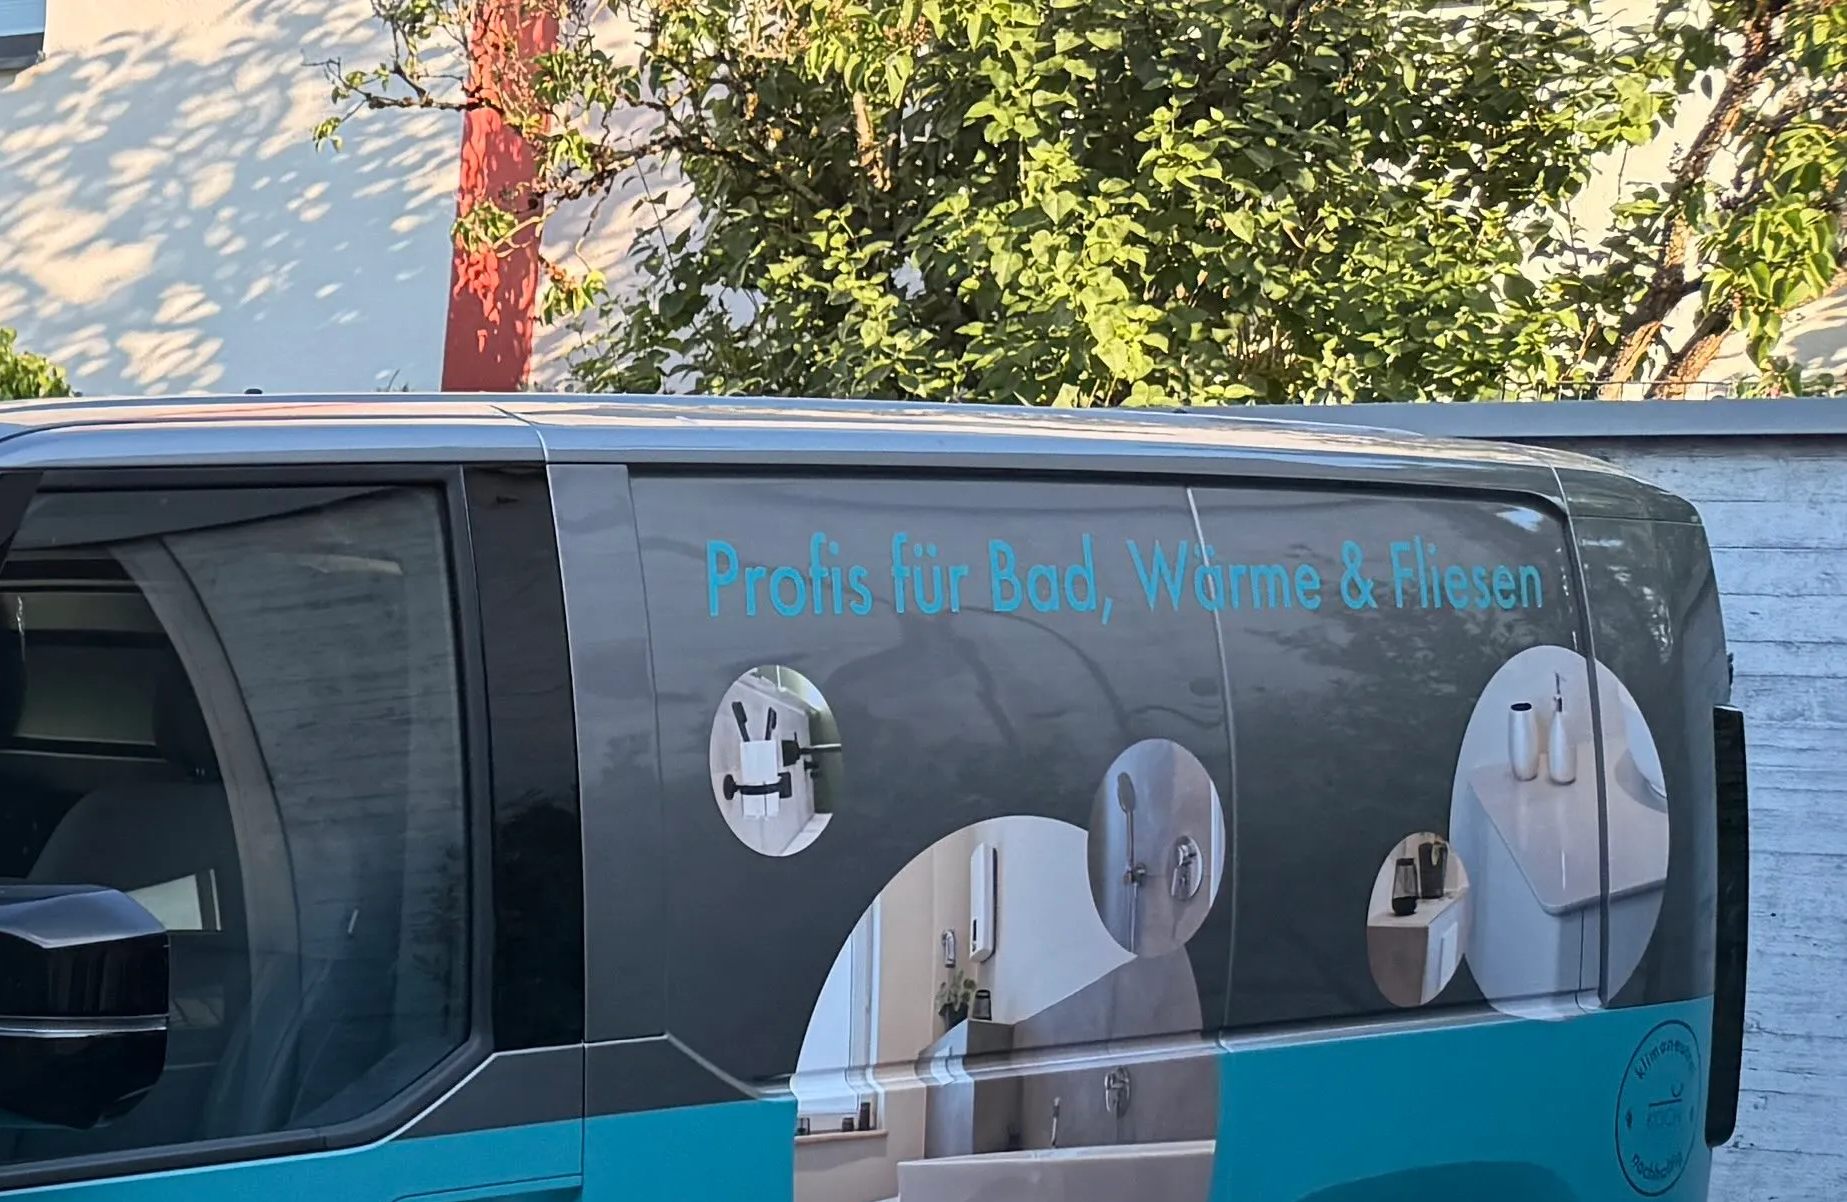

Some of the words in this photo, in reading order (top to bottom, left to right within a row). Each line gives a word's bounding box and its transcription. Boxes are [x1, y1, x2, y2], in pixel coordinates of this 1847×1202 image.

[707, 532, 874, 618] Profis
[891, 531, 969, 615] für
[989, 532, 1113, 625] Bad,
[1126, 539, 1322, 612] Wärme
[1339, 540, 1378, 611] &
[1388, 535, 1545, 611] Fliesen
